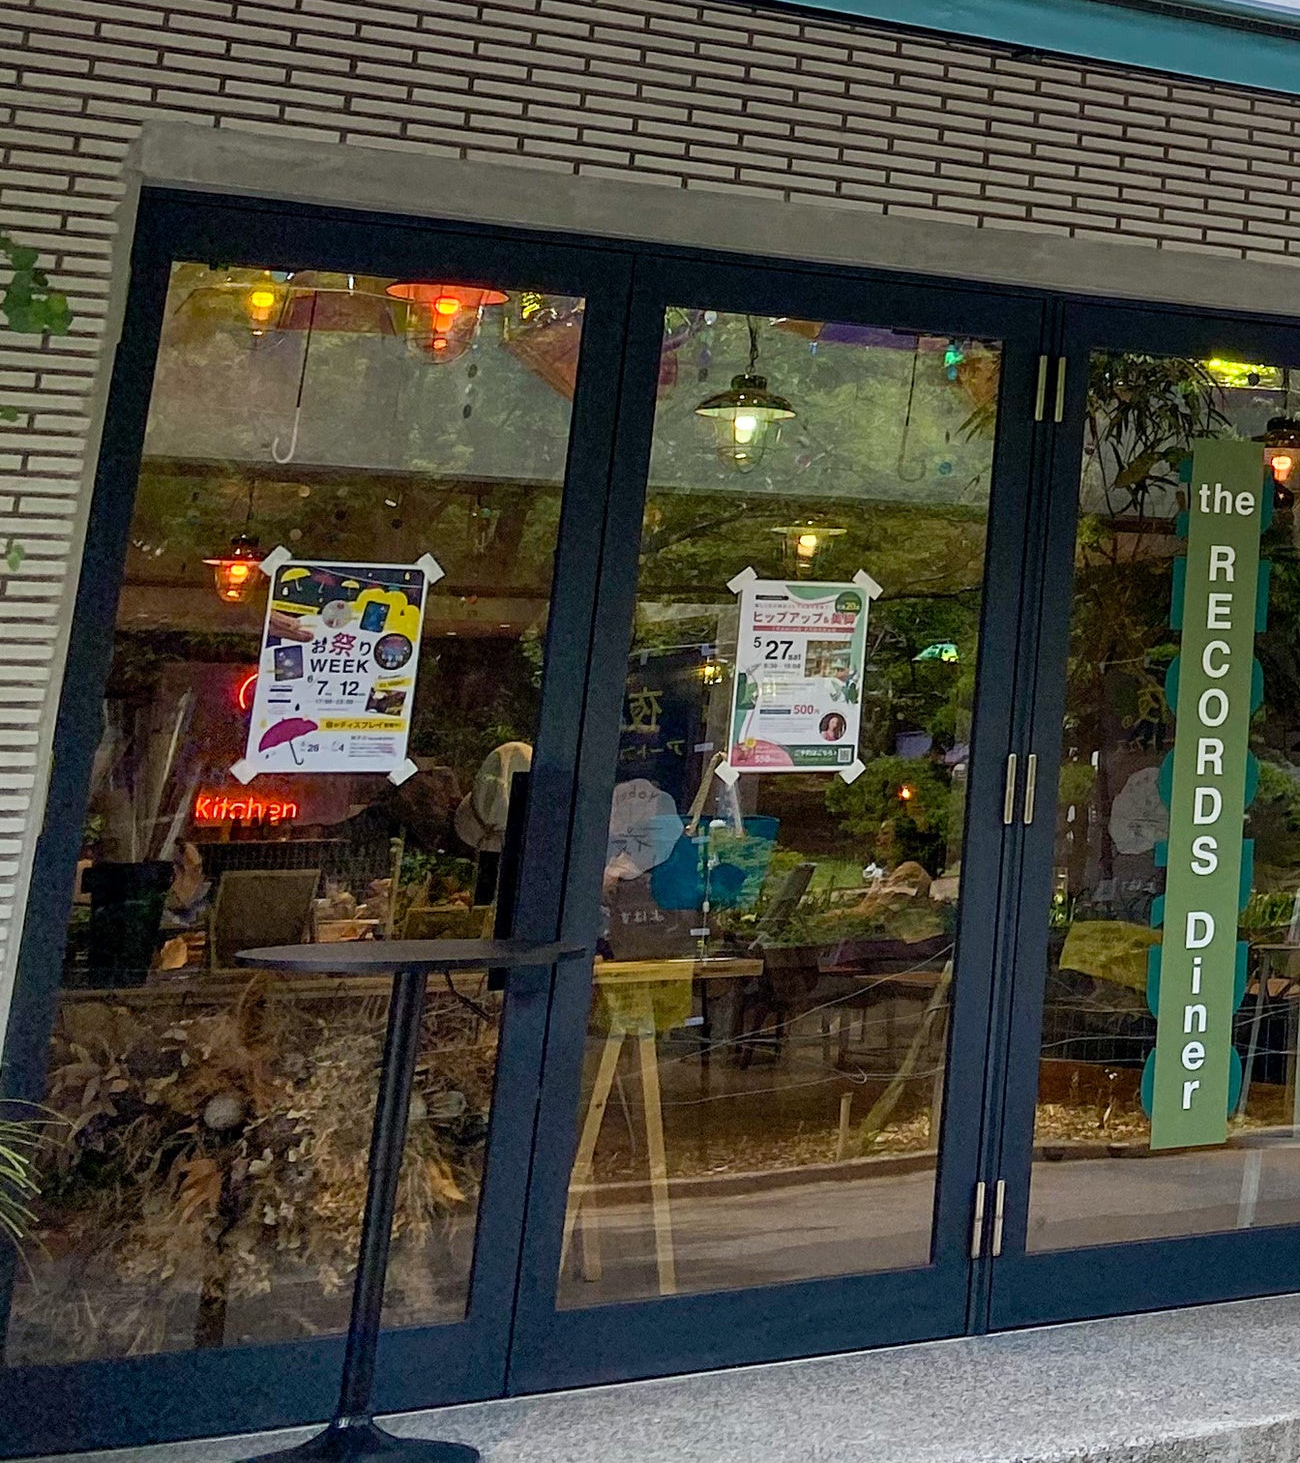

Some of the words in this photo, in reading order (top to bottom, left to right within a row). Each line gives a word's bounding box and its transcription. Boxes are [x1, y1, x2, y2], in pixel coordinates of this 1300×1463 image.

[1199, 483, 1255, 516] the
[312, 632, 372, 657] お祭り
[753, 636, 762, 648] 5
[765, 640, 794, 659] 27
[310, 659, 370, 674] WEEK
[317, 681, 329, 696] 7
[340, 681, 360, 696] 12
[1190, 545, 1236, 875] RECORDS
[195, 796, 298, 822] Kitchen
[1181, 911, 1215, 1110] Diner
